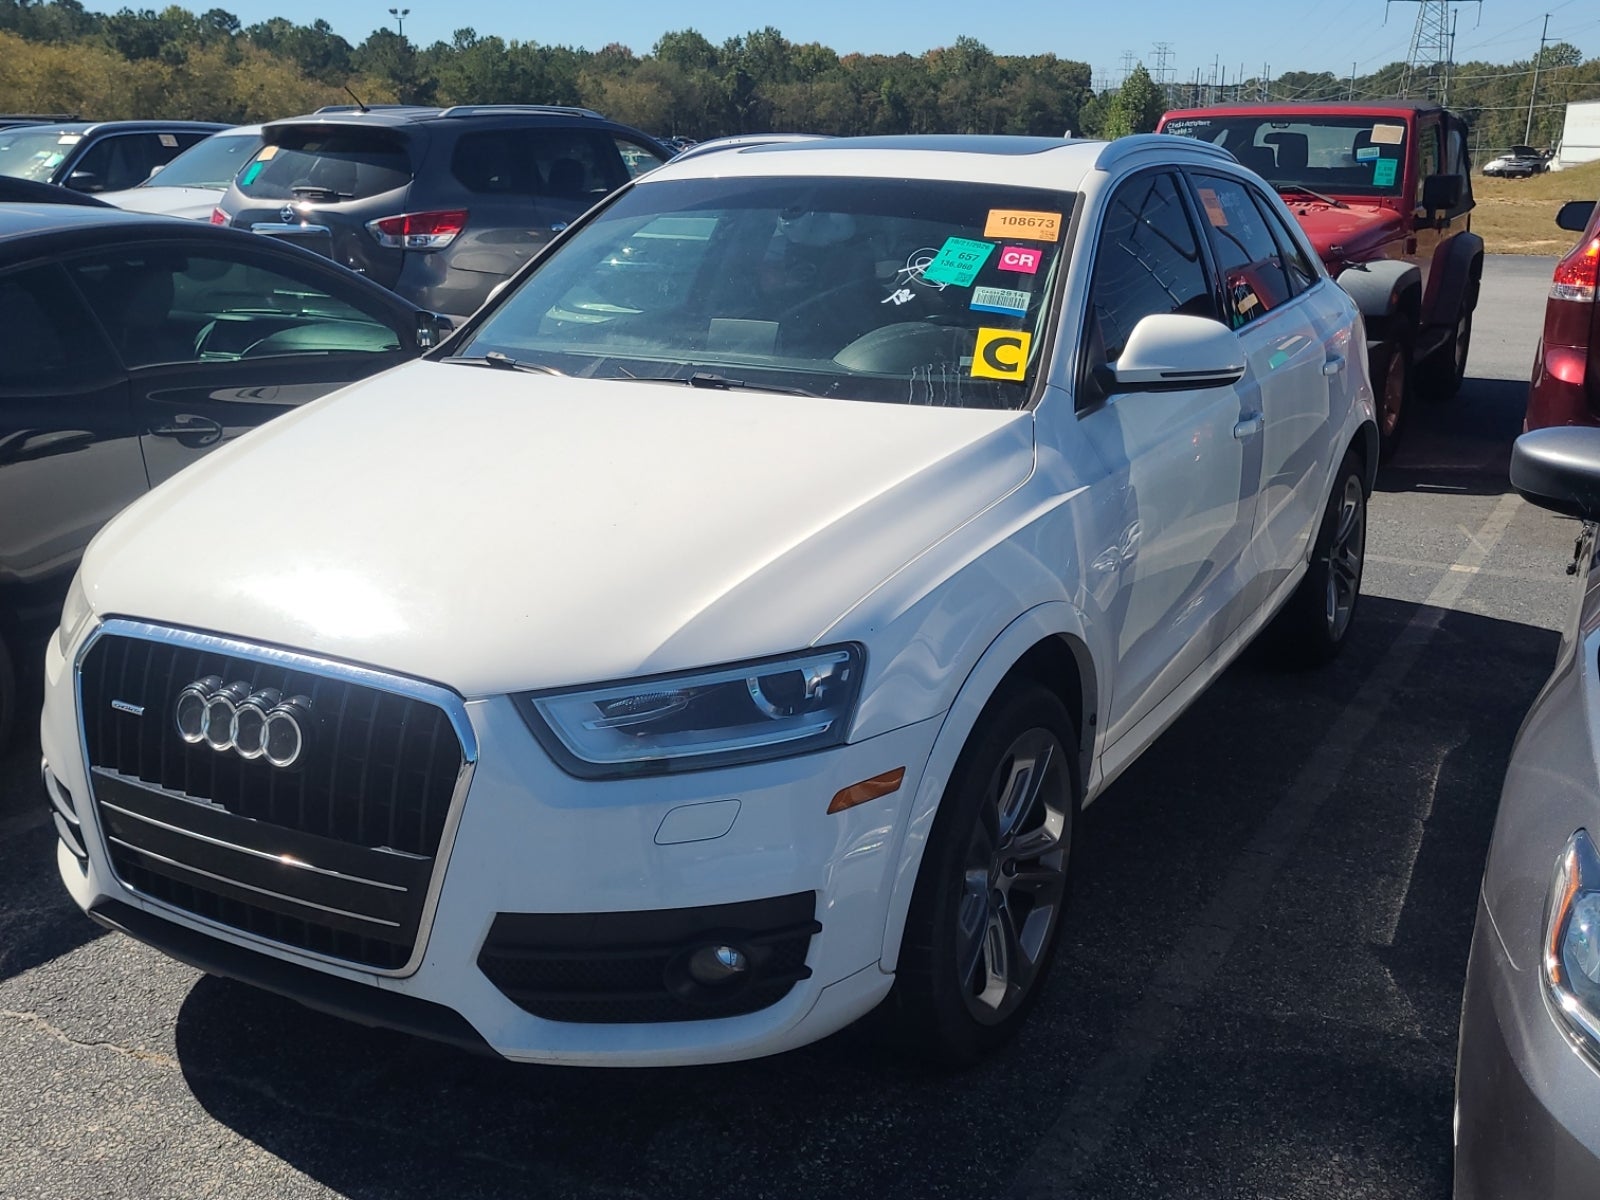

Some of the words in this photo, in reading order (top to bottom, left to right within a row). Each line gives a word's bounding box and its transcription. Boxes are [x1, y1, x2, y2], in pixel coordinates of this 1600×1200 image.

[1001, 216, 1055, 229] 108673
[958, 252, 980, 262] 657
[1004, 252, 1035, 267] CR
[983, 336, 1022, 373] C
